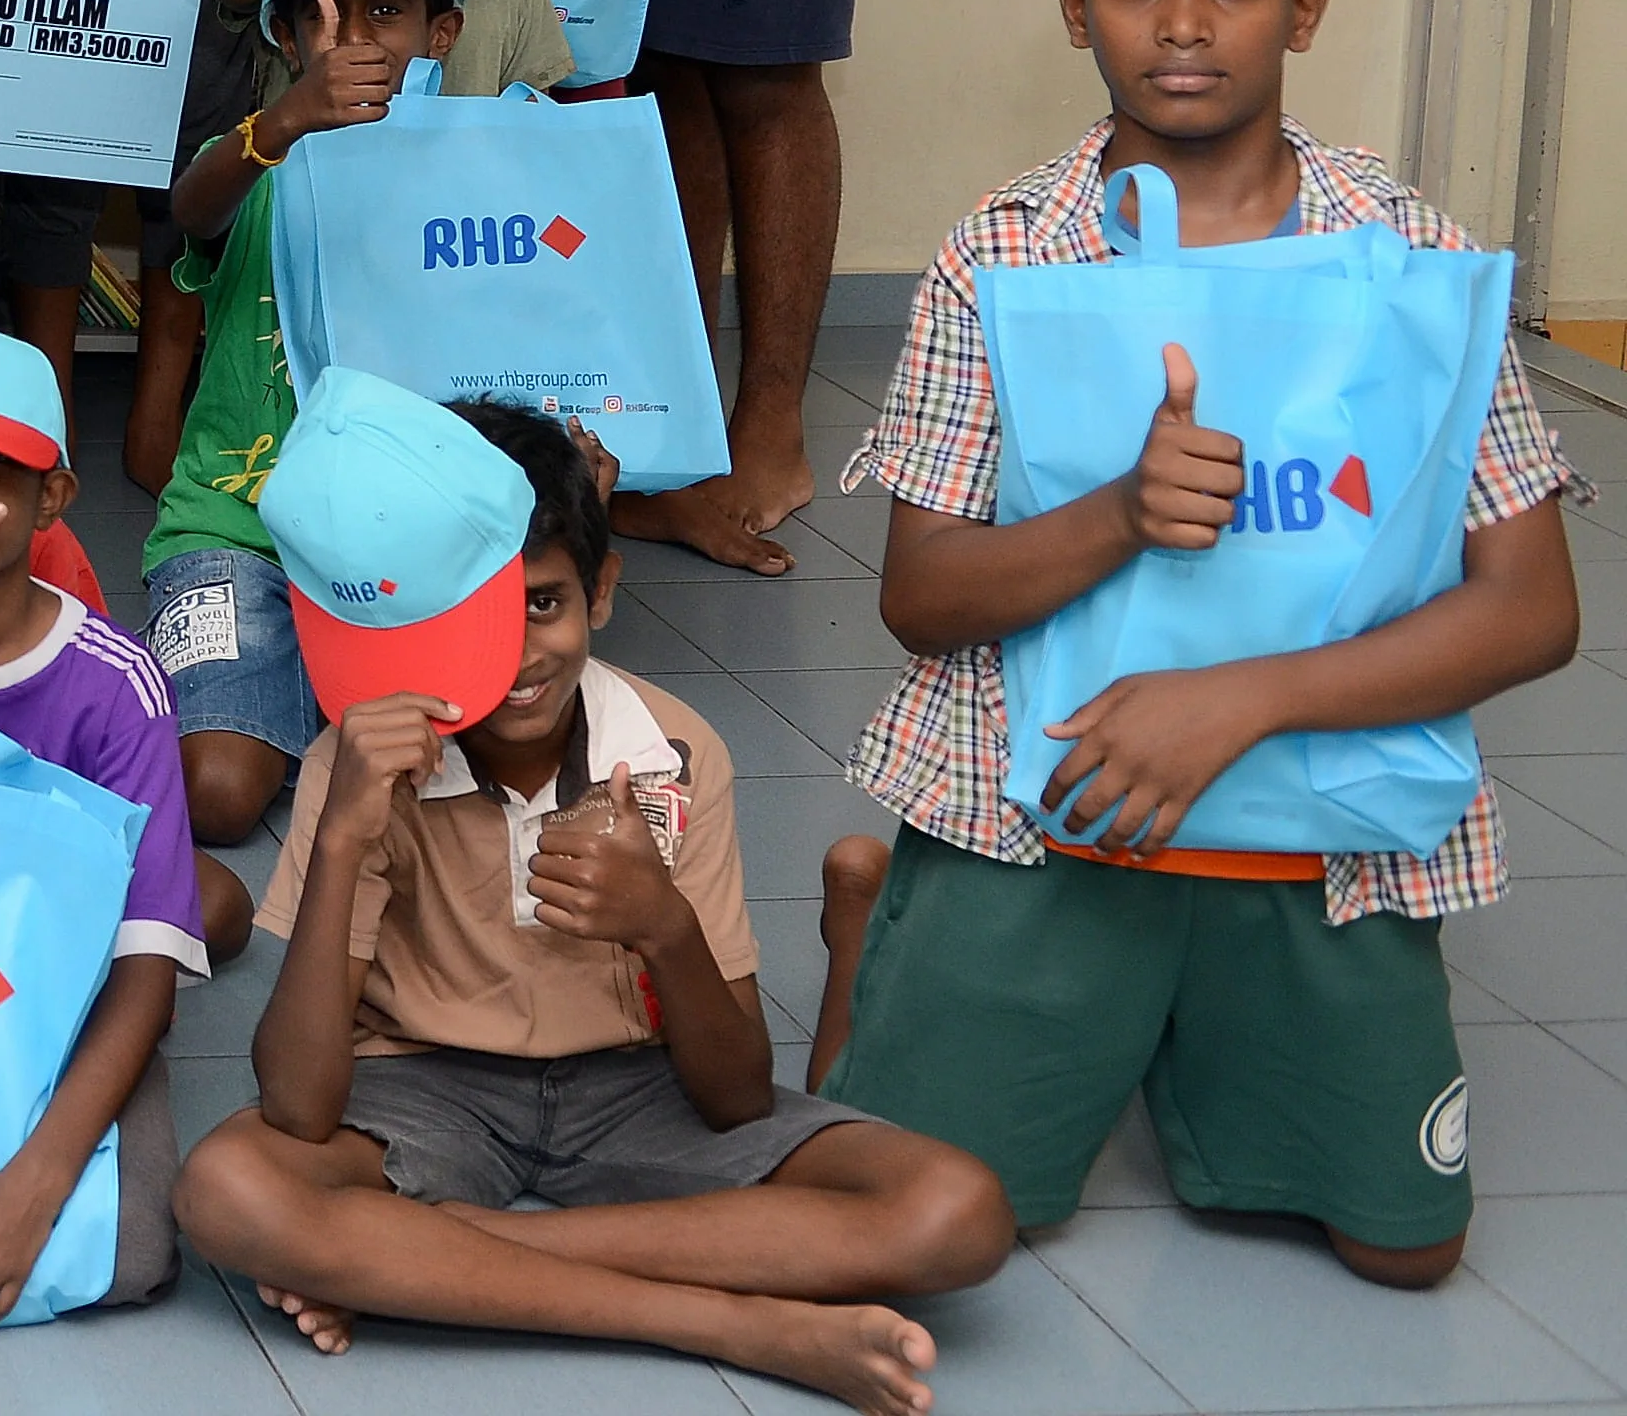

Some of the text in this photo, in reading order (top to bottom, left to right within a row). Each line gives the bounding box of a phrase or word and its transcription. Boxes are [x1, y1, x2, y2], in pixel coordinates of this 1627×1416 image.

[35, 28, 166, 64] RM3,500.00
[423, 214, 539, 270] RHB
[450, 370, 608, 391] www.rhbgroup.com
[576, 404, 601, 415] Group
[1232, 458, 1326, 534] HB
[331, 581, 377, 604] RHB
[175, 645, 228, 667] HAPPY
